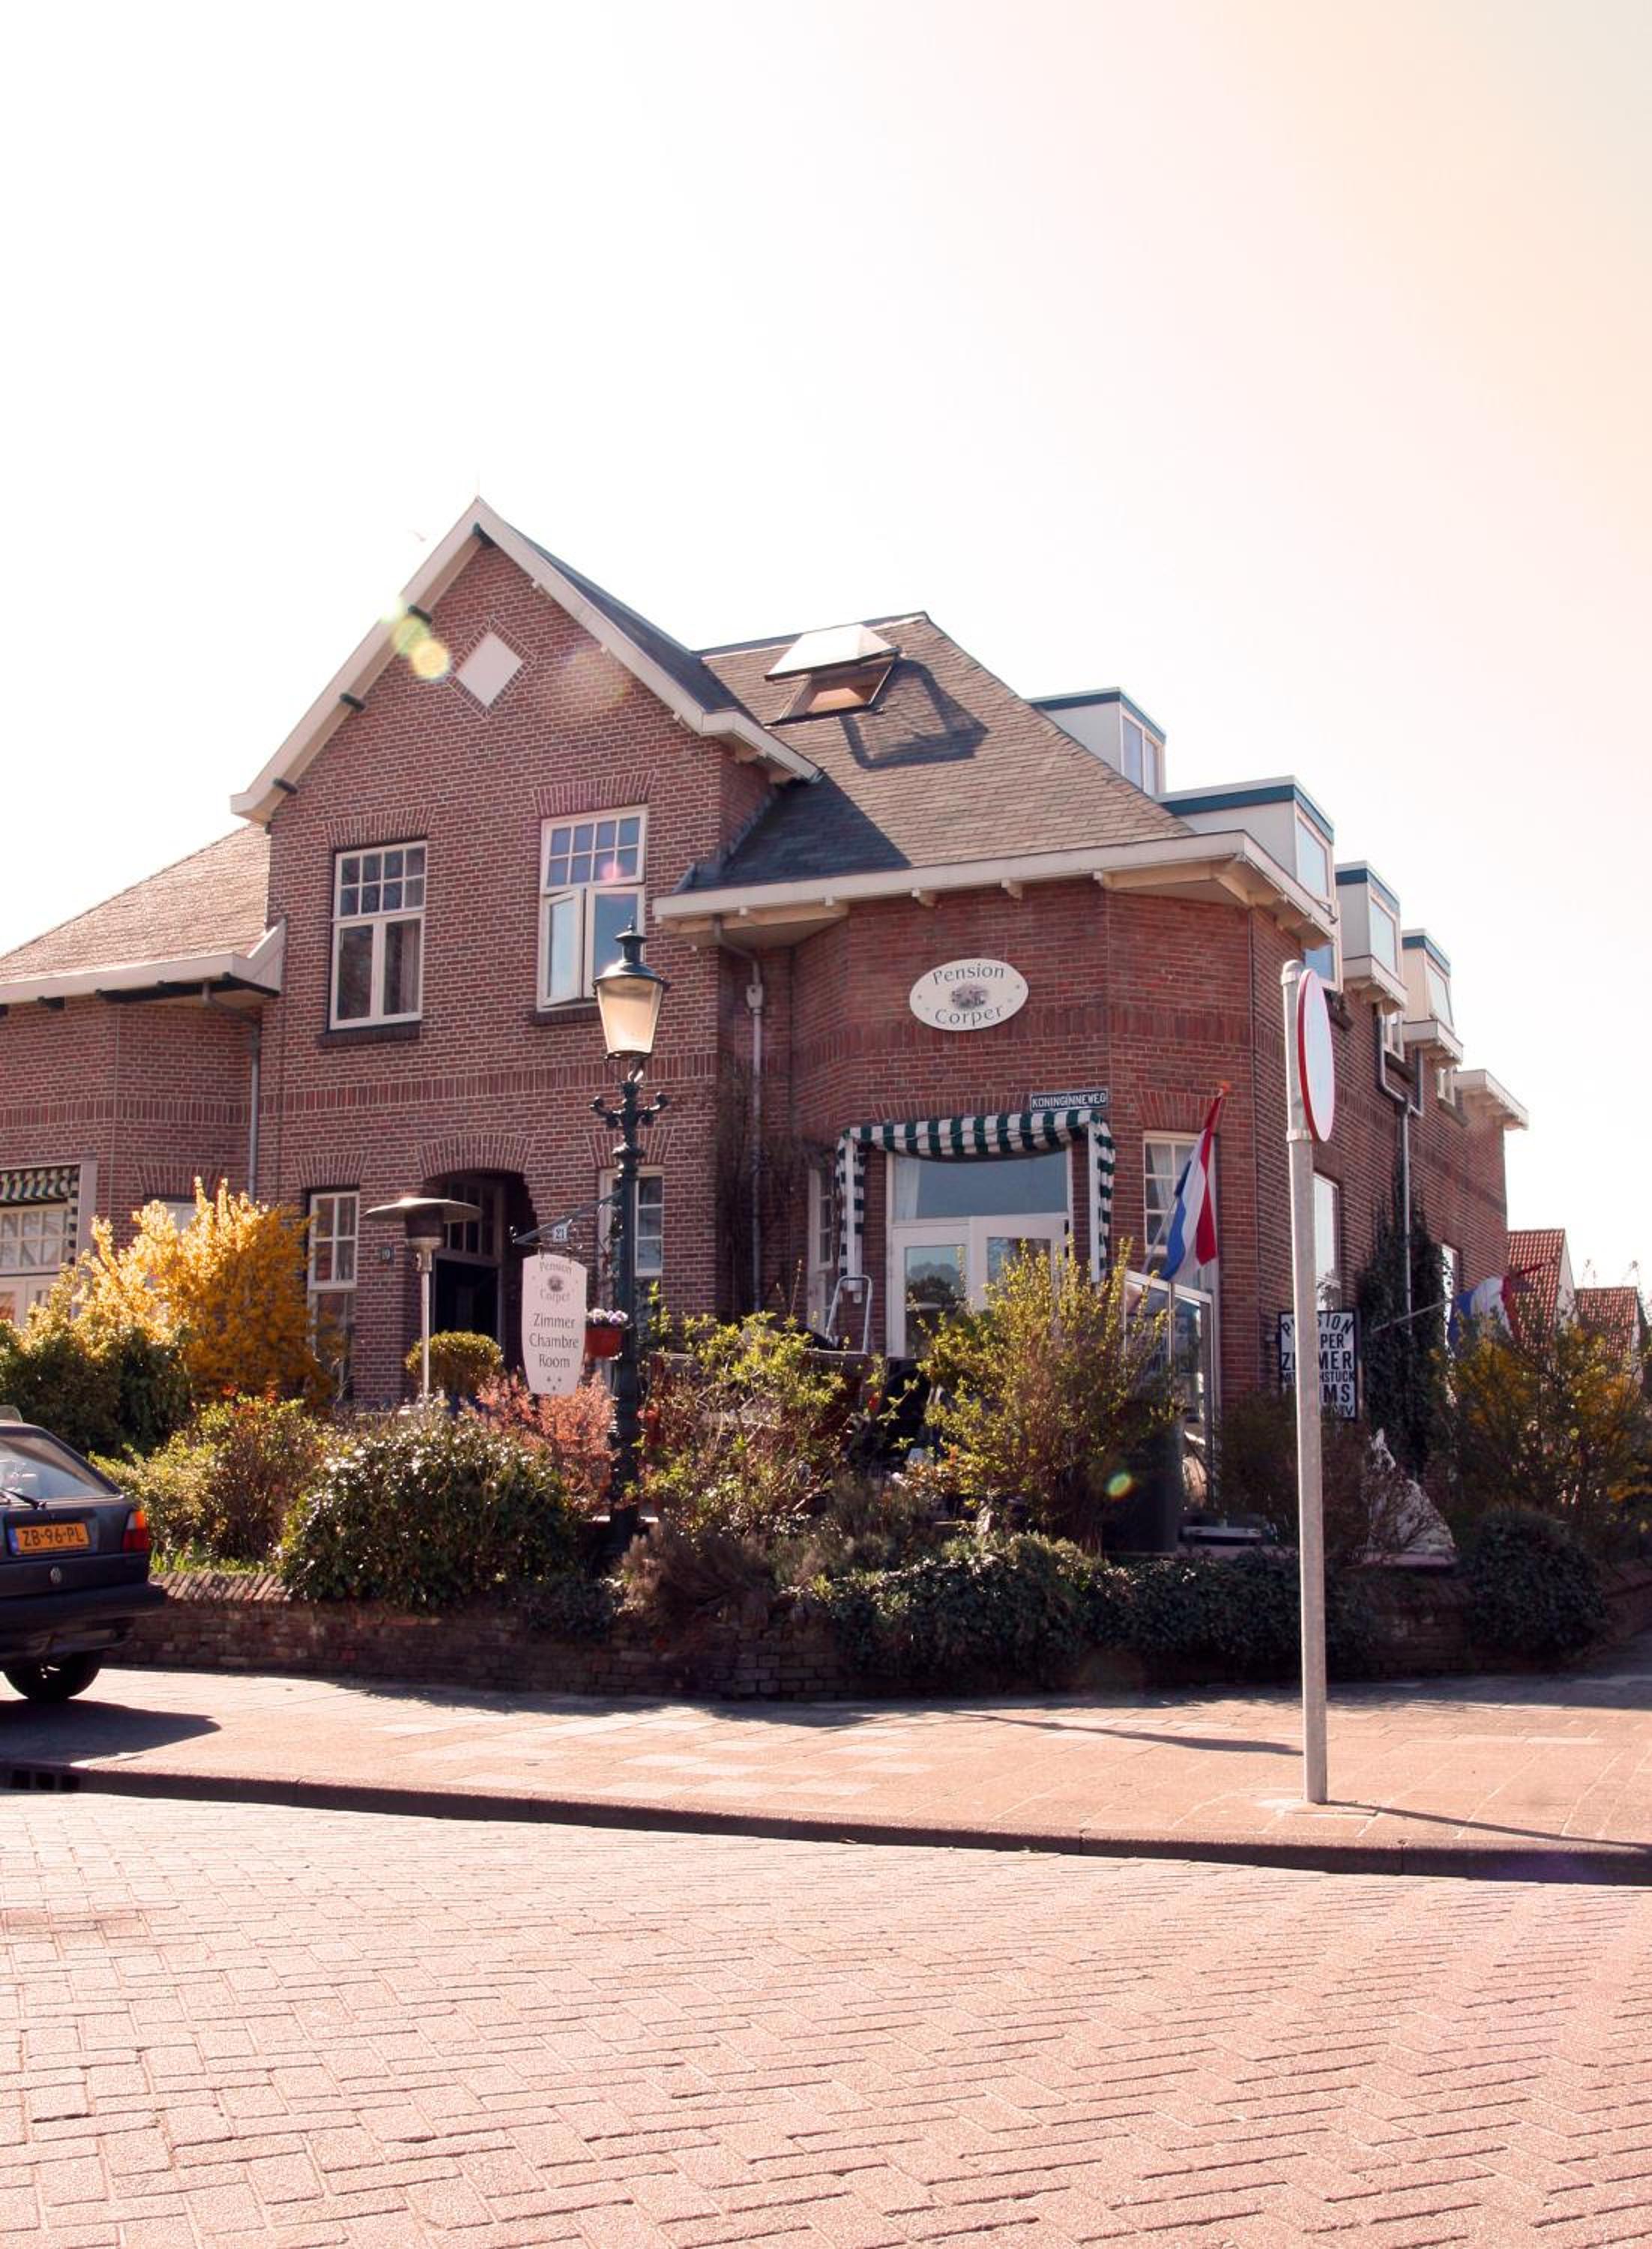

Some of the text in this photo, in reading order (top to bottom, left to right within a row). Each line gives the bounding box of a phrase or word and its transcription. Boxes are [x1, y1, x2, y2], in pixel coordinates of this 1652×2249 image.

[933, 963, 1004, 985] Pension
[935, 1007, 1003, 1027] Corper
[533, 1313, 576, 1328] Zimmer
[529, 1332, 579, 1349] Chambre
[540, 1353, 570, 1368] Room
[1282, 1350, 1352, 1370] ZIMER
[22, 1526, 85, 1547] ZB-96-PL
